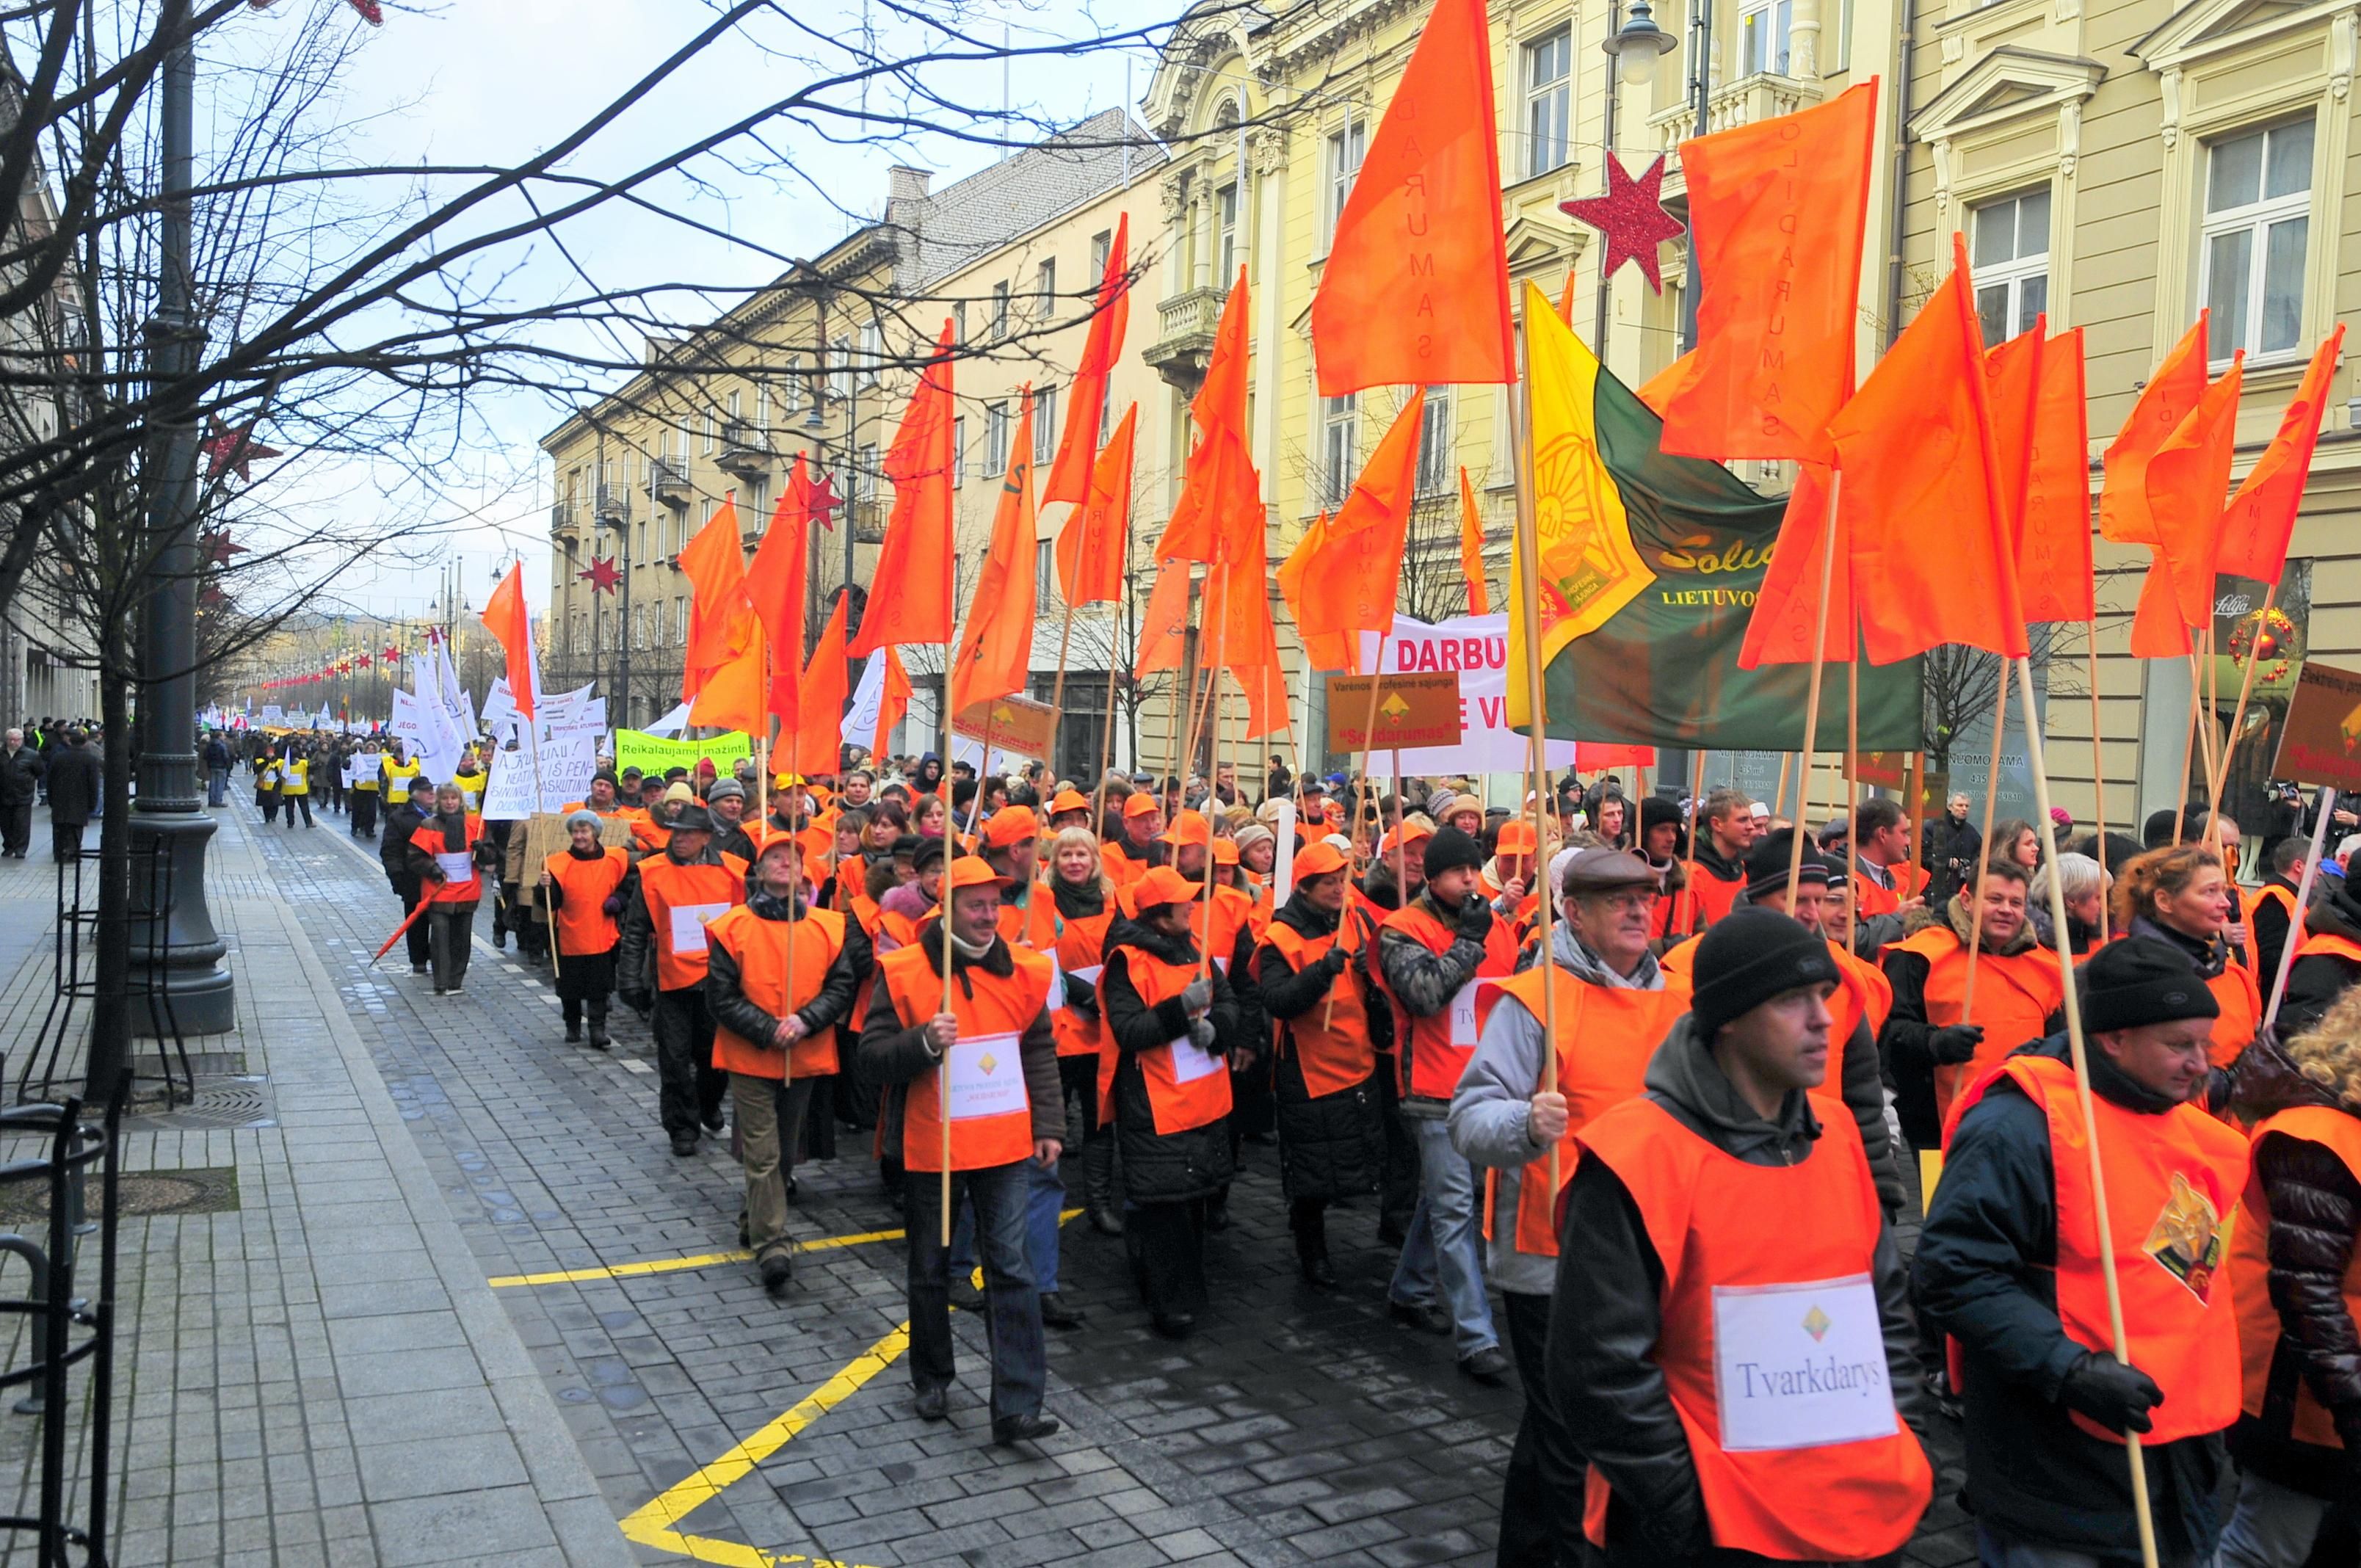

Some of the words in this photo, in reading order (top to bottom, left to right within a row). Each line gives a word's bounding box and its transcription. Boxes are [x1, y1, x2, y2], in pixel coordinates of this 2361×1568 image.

[1377, 679, 1415, 690] rofesinė
[1948, 753, 2024, 767] NUOMOAMA
[1736, 1355, 1882, 1398] Tvarkdarys
